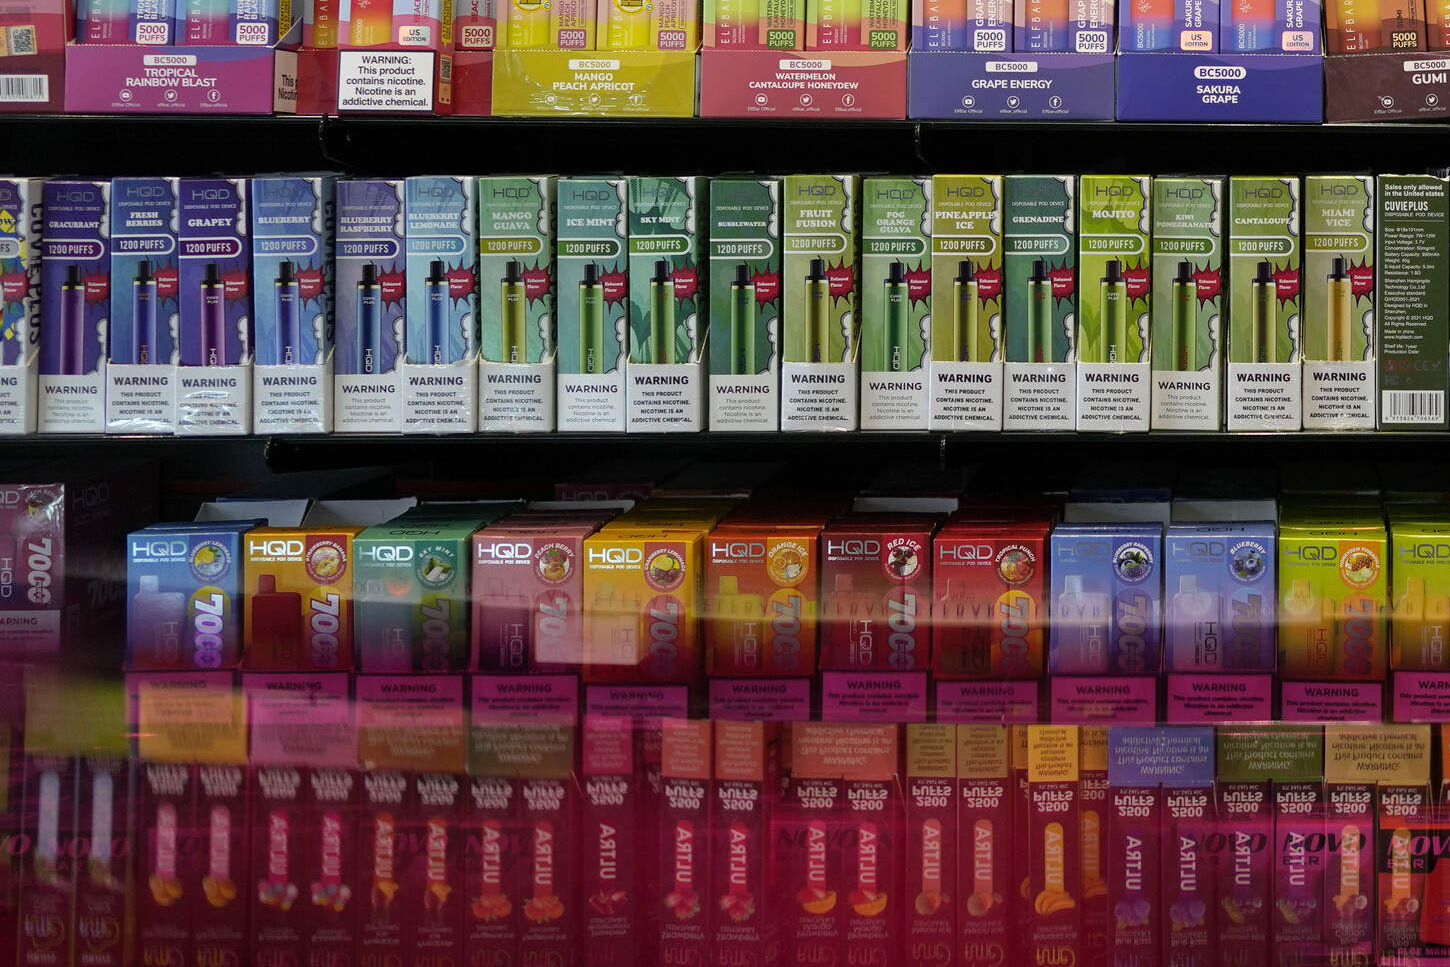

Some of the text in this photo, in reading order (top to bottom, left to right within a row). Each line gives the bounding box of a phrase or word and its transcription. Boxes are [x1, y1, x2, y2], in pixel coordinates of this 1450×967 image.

[145, 68, 198, 78] TROPICAL
[574, 73, 613, 81] MANGO
[776, 73, 836, 81] WATERMELON
[126, 78, 217, 87] RAINBOW BLAST
[1412, 73, 1446, 85] GUMI
[553, 82, 635, 91] PEACH APRICOT
[749, 81, 858, 90] CANTALOUPE HONEYDEW
[972, 79, 1052, 89] GRAPE ENERGY
[1196, 86, 1241, 94] SAKURA
[1202, 94, 1238, 103] GRAPE
[800, 210, 831, 218] FRUIT
[1092, 210, 1135, 219] MOJITO
[188, 218, 232, 227] GRAPEY
[796, 219, 836, 228] FUSION
[635, 376, 689, 384] WARNING
[887, 538, 922, 551] RED ICE
[133, 541, 187, 558] HQD
[848, 678, 903, 690] WARNING
